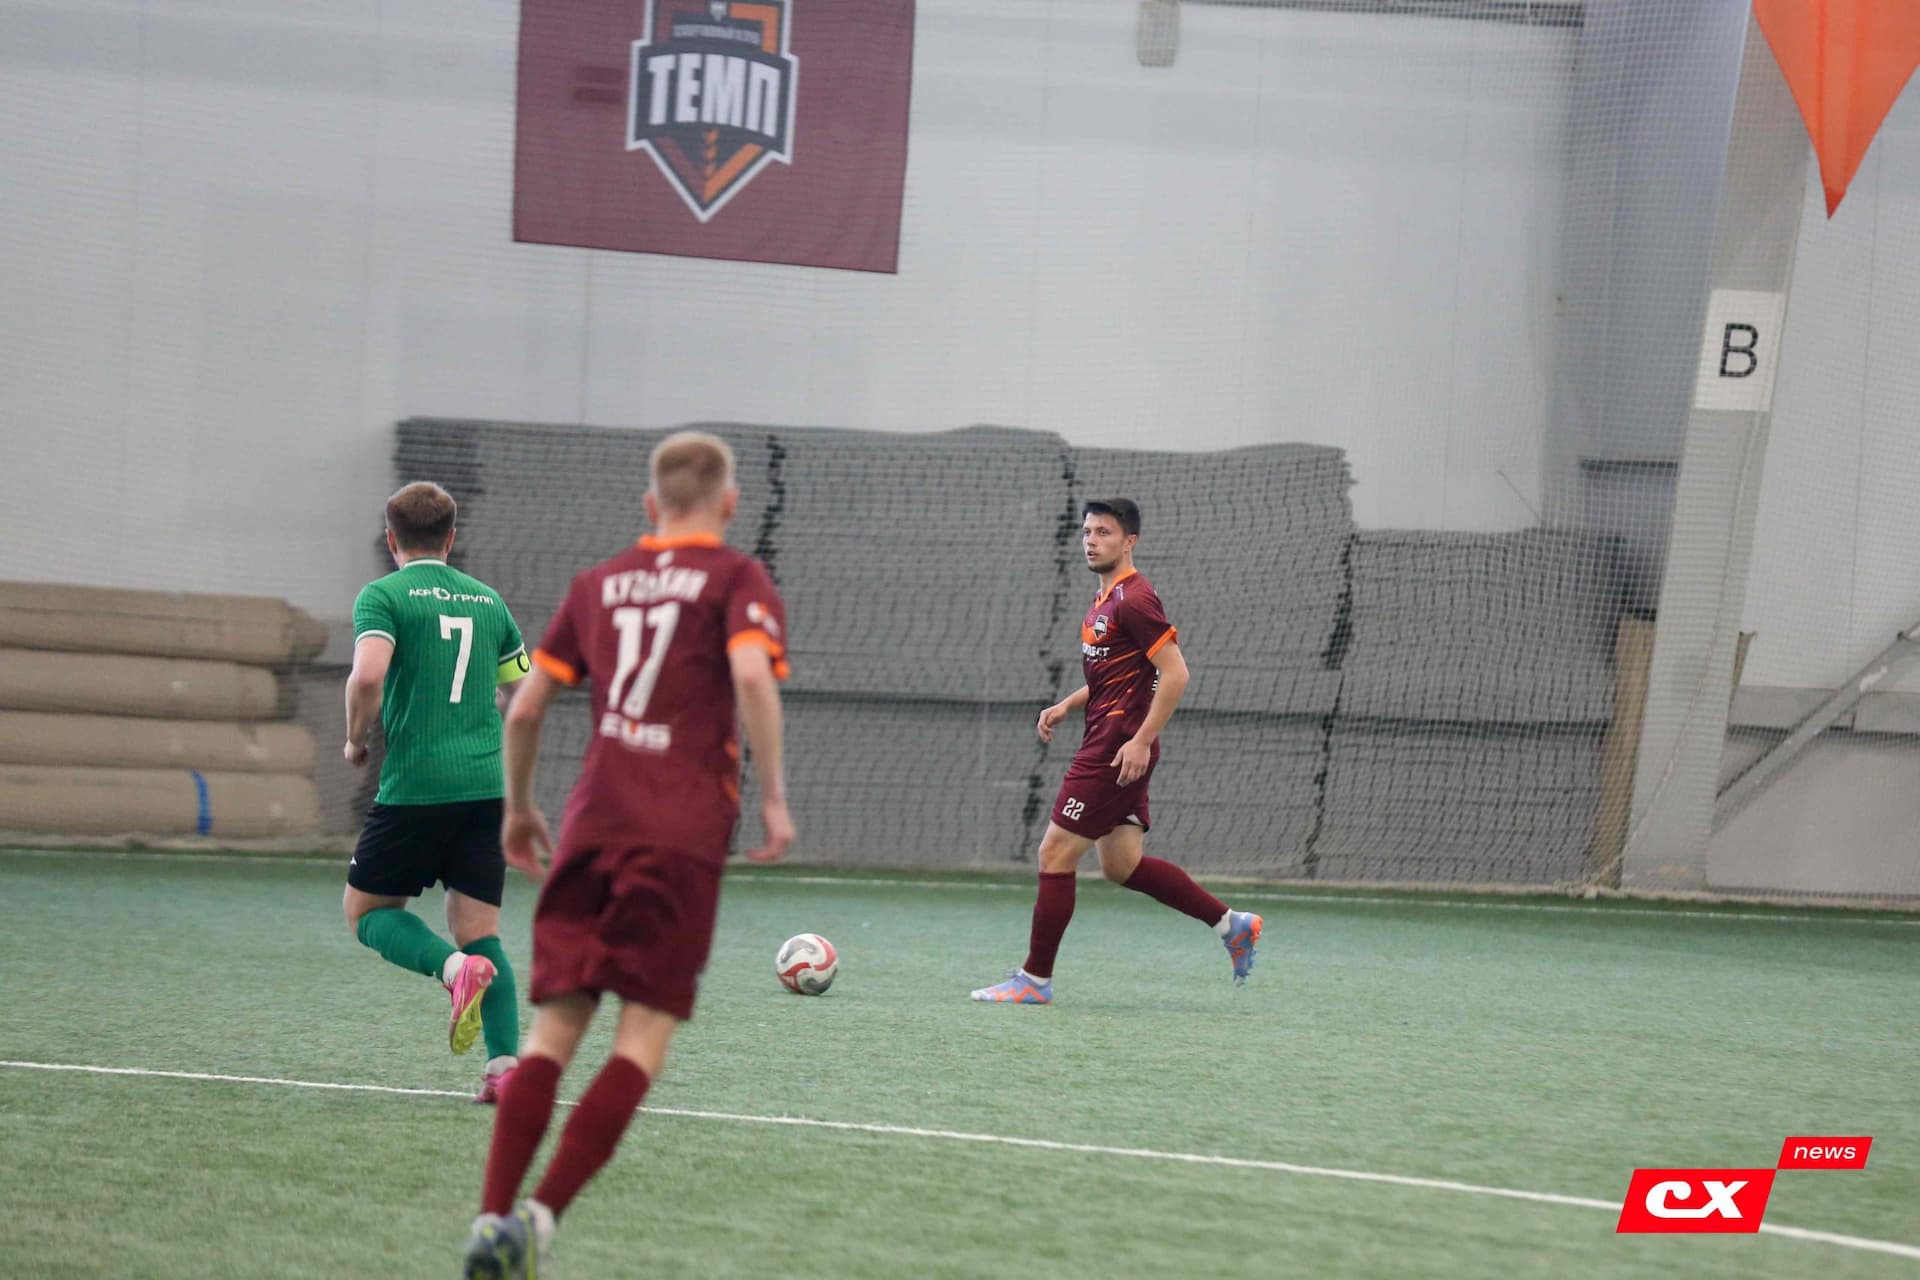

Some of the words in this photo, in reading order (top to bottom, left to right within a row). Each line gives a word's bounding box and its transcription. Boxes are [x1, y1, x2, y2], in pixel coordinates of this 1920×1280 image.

[646, 52, 781, 138] ТЕМП
[439, 614, 473, 703] 7
[1062, 797, 1085, 821] 22
